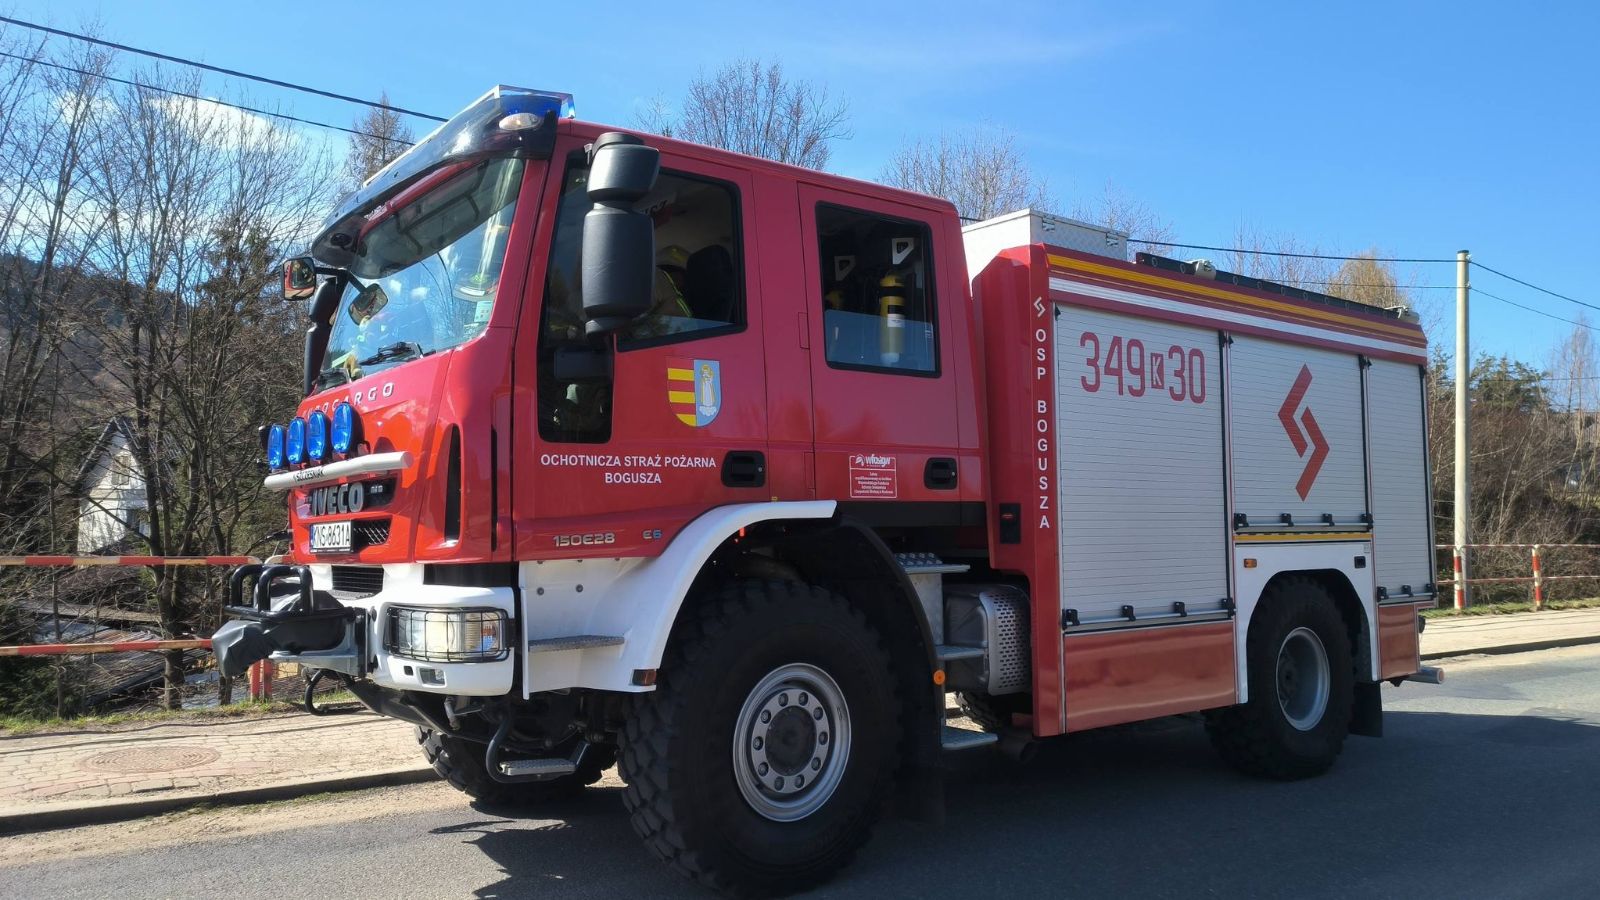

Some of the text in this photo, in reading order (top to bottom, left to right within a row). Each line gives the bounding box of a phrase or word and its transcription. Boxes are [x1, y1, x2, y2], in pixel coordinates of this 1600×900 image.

[1035, 328, 1050, 529] OSP BOGUSZA
[540, 454, 716, 468] OCHOTNICZA STRAŻ POŻARNA
[604, 472, 662, 484] BOGUSZA
[311, 481, 365, 517] IVECO
[328, 523, 351, 547] 8631A
[553, 529, 663, 547] 150E28 E6
